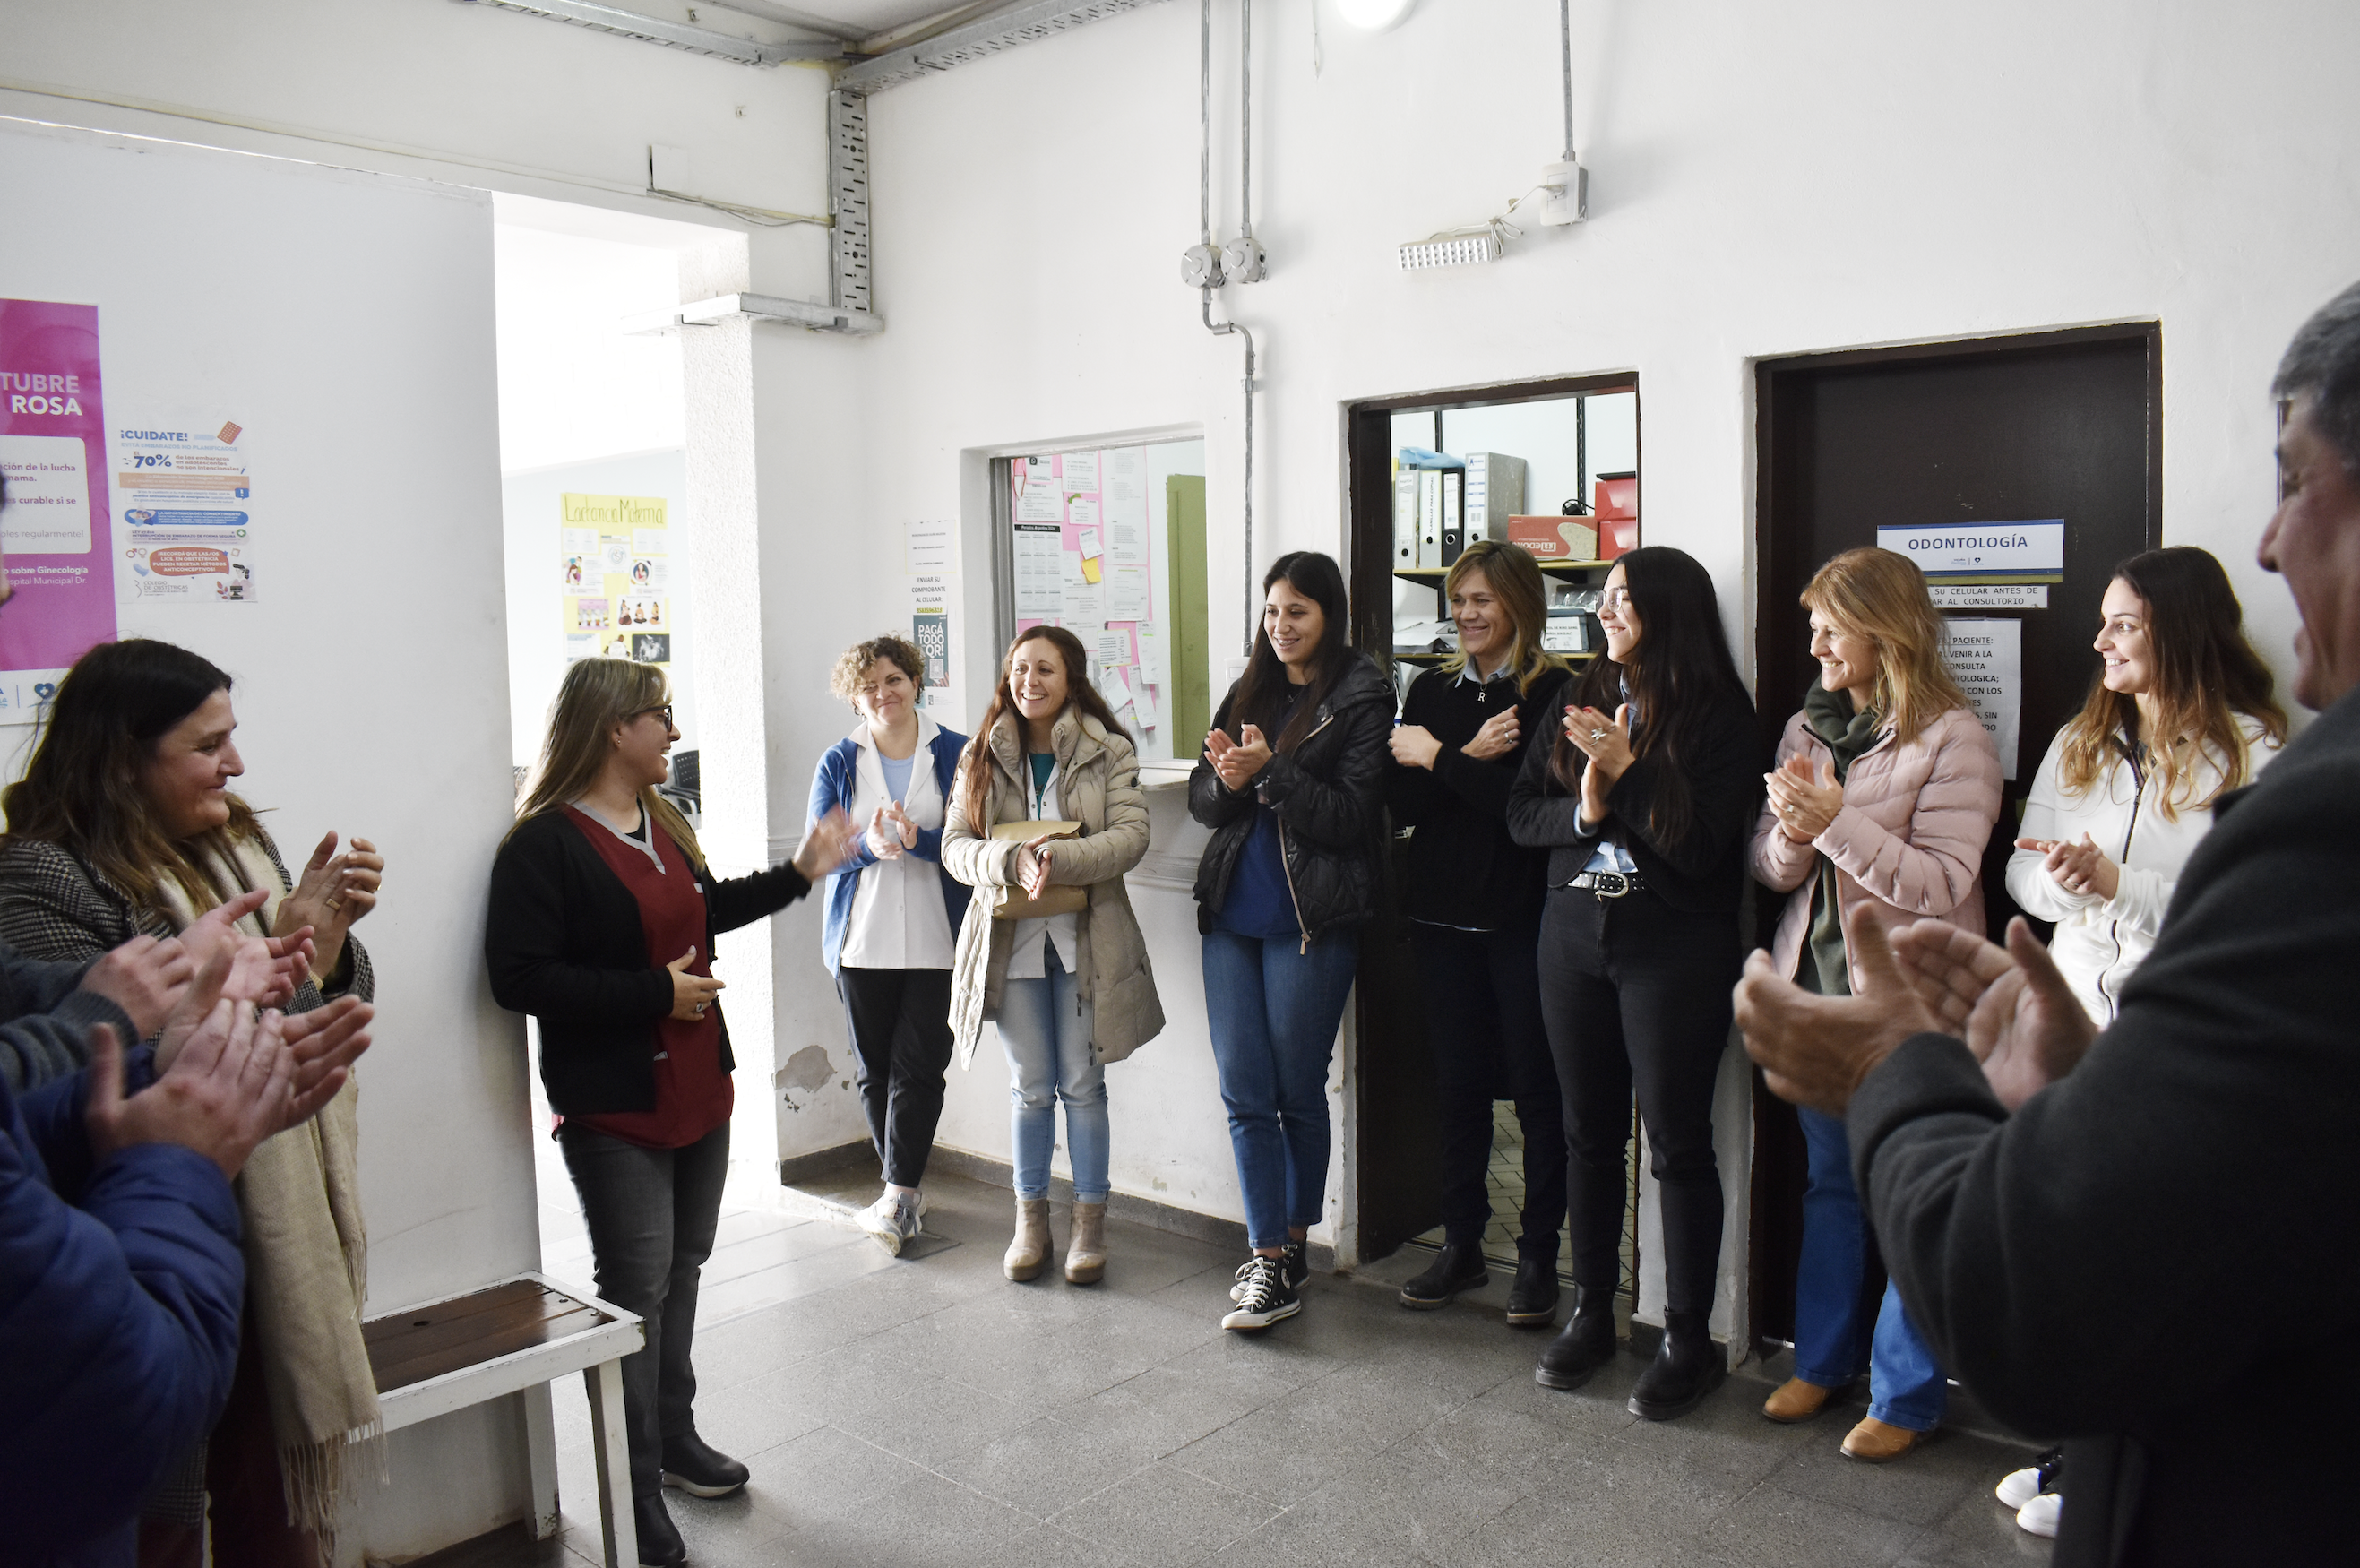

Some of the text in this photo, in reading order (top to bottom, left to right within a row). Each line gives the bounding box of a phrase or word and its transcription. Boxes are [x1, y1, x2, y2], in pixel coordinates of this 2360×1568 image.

[12, 394, 82, 416] ROSA
[121, 430, 188, 441] ¡CUIDATE!
[134, 454, 172, 468] 70%
[40, 463, 48, 471] la
[51, 463, 75, 471] lucha
[564, 495, 664, 524] Lactancia Materna
[22, 530, 84, 539] regularmente!
[1908, 534, 2028, 550] ODONTOLOGÍA
[11, 566, 35, 574] sobre
[37, 565, 88, 575] Ginecología
[7, 576, 87, 586] spital Municipal Dr.
[918, 622, 943, 635] PAGÁ
[918, 634, 944, 644] TODO
[926, 644, 944, 658] QR!
[1477, 692, 1486, 702] R
